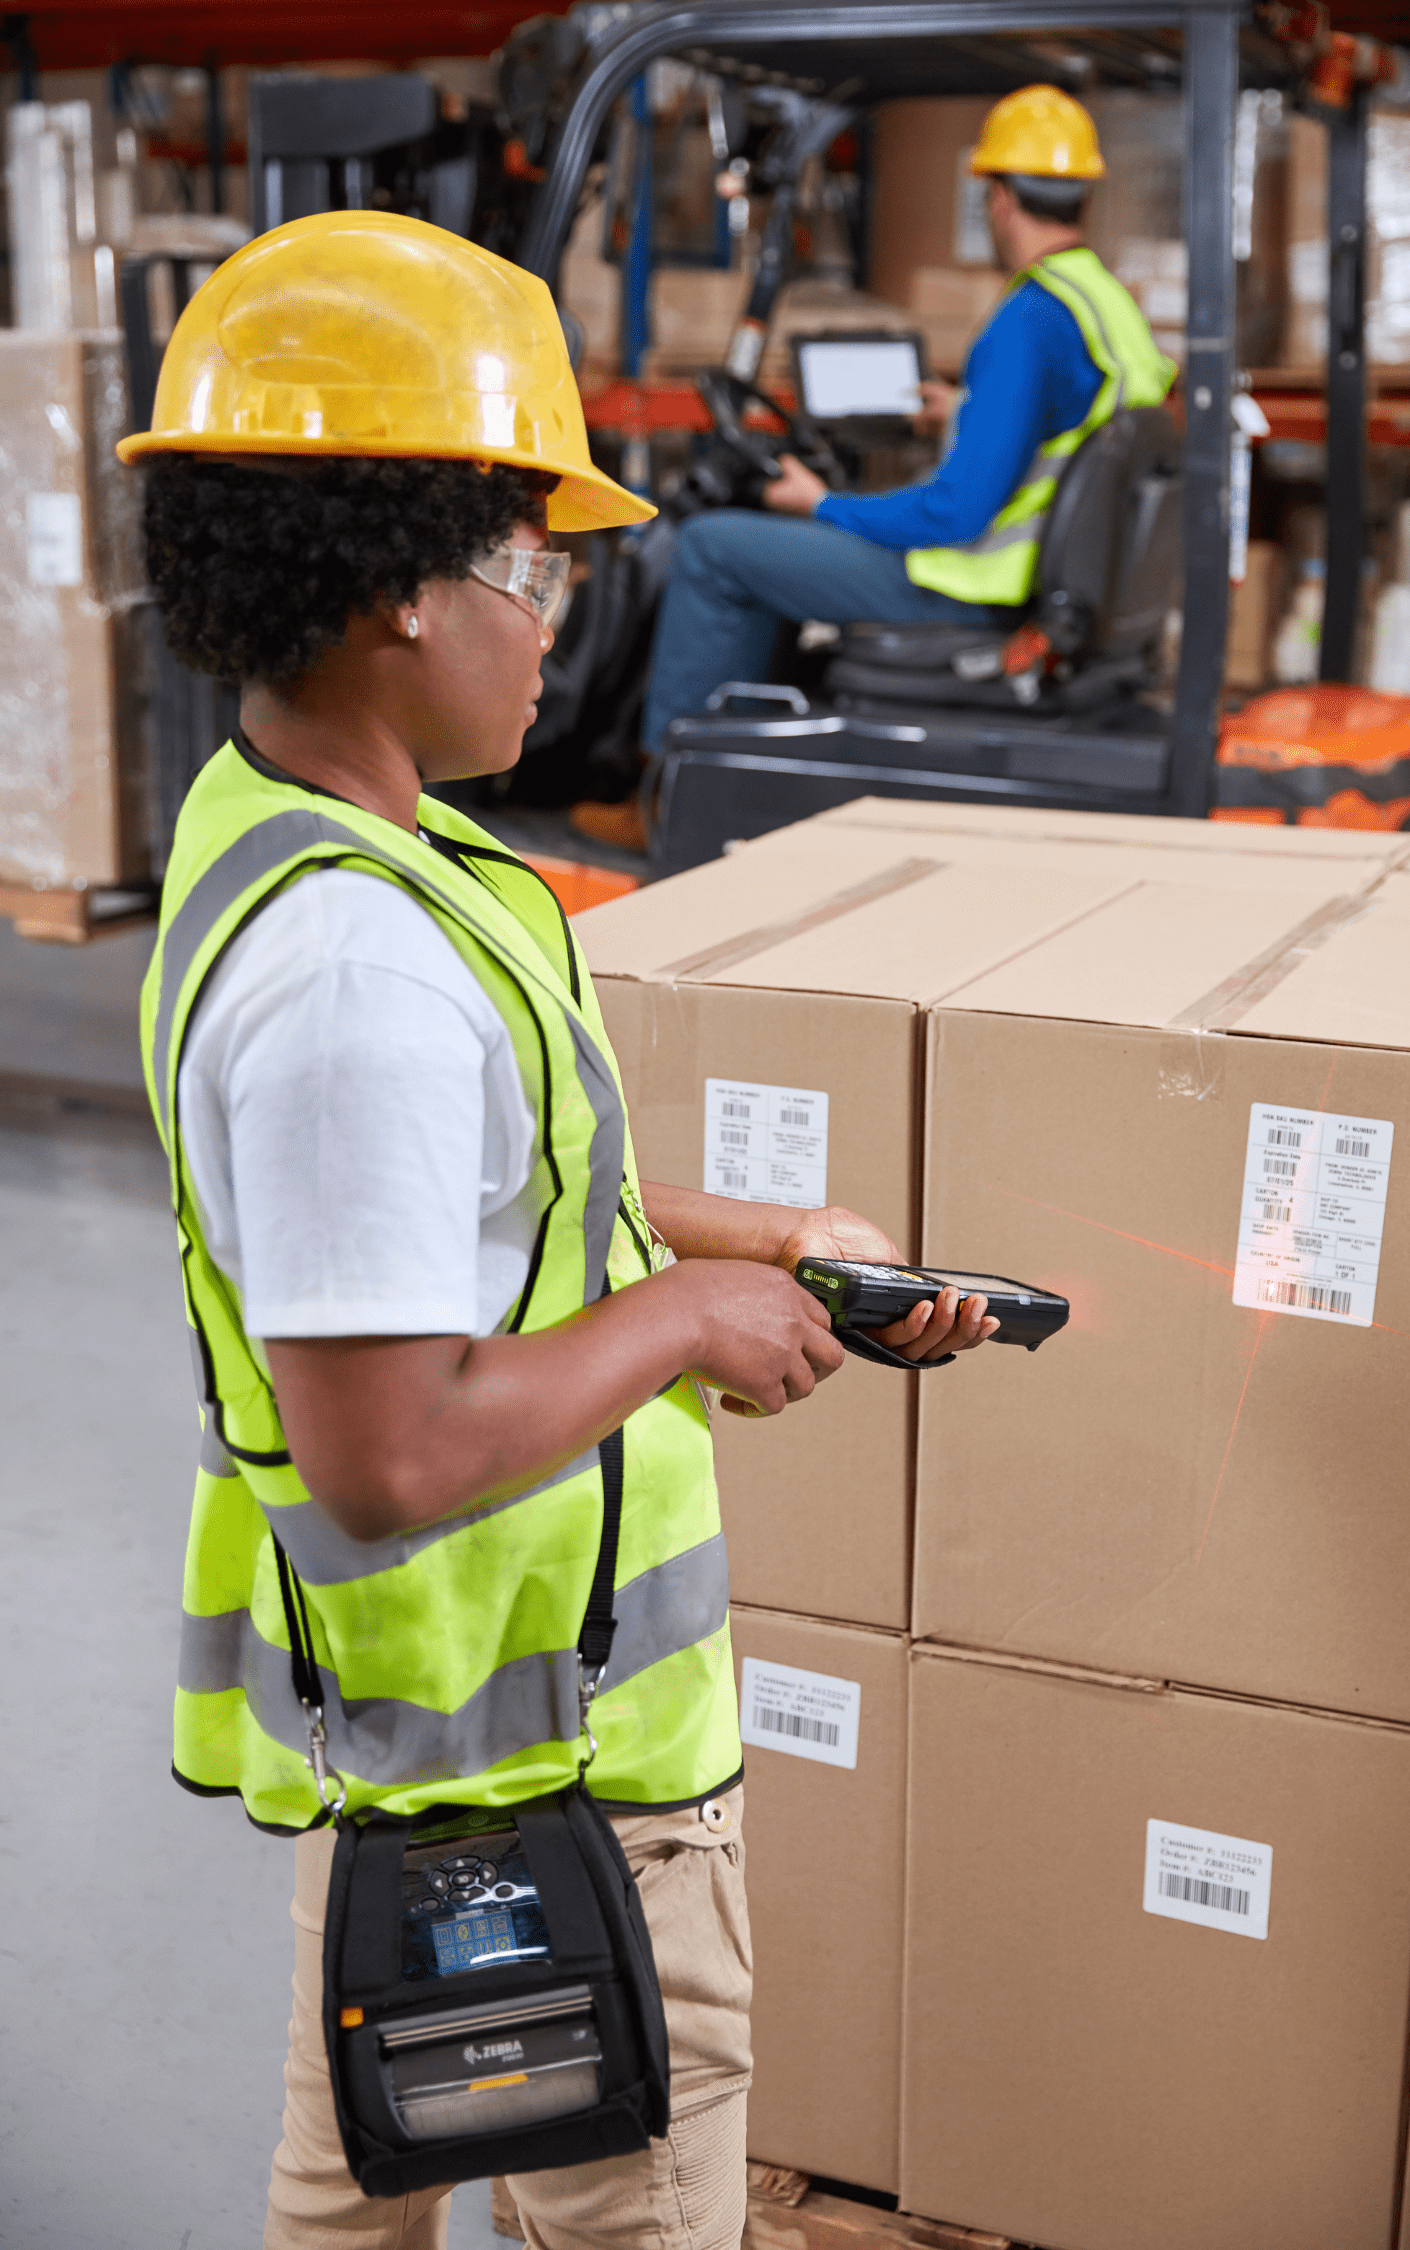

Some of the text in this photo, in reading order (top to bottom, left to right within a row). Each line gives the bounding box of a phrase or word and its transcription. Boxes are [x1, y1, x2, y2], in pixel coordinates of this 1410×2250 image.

[1289, 1117, 1314, 1125] NUMBER
[1352, 1126, 1377, 1135] NUMBER
[1160, 1836, 1204, 1852] Customer
[1160, 1848, 1188, 1861] Order
[1160, 1859, 1180, 1871] Item
[1197, 1868, 1215, 1879] ABC
[1218, 1872, 1234, 1884] 123
[483, 2040, 523, 2058] ZEBRA
